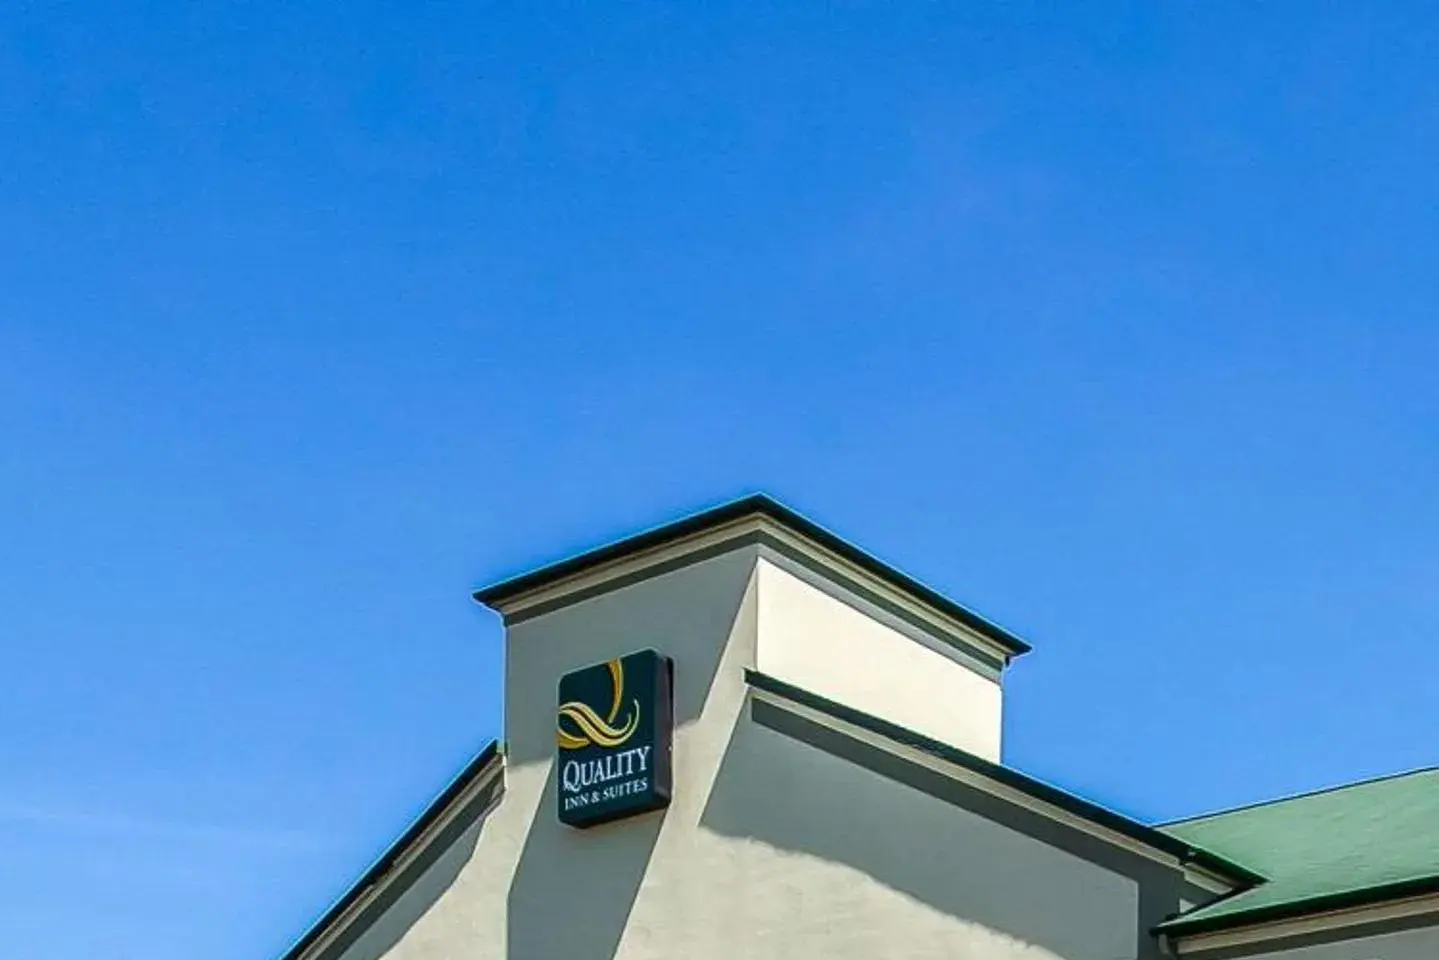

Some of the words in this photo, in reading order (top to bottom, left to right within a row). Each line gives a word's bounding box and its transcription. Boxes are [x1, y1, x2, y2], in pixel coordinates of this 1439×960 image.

[562, 746, 651, 792] QUALITY
[565, 793, 589, 811] INN
[591, 791, 602, 804] &
[603, 778, 648, 801] SUITES
